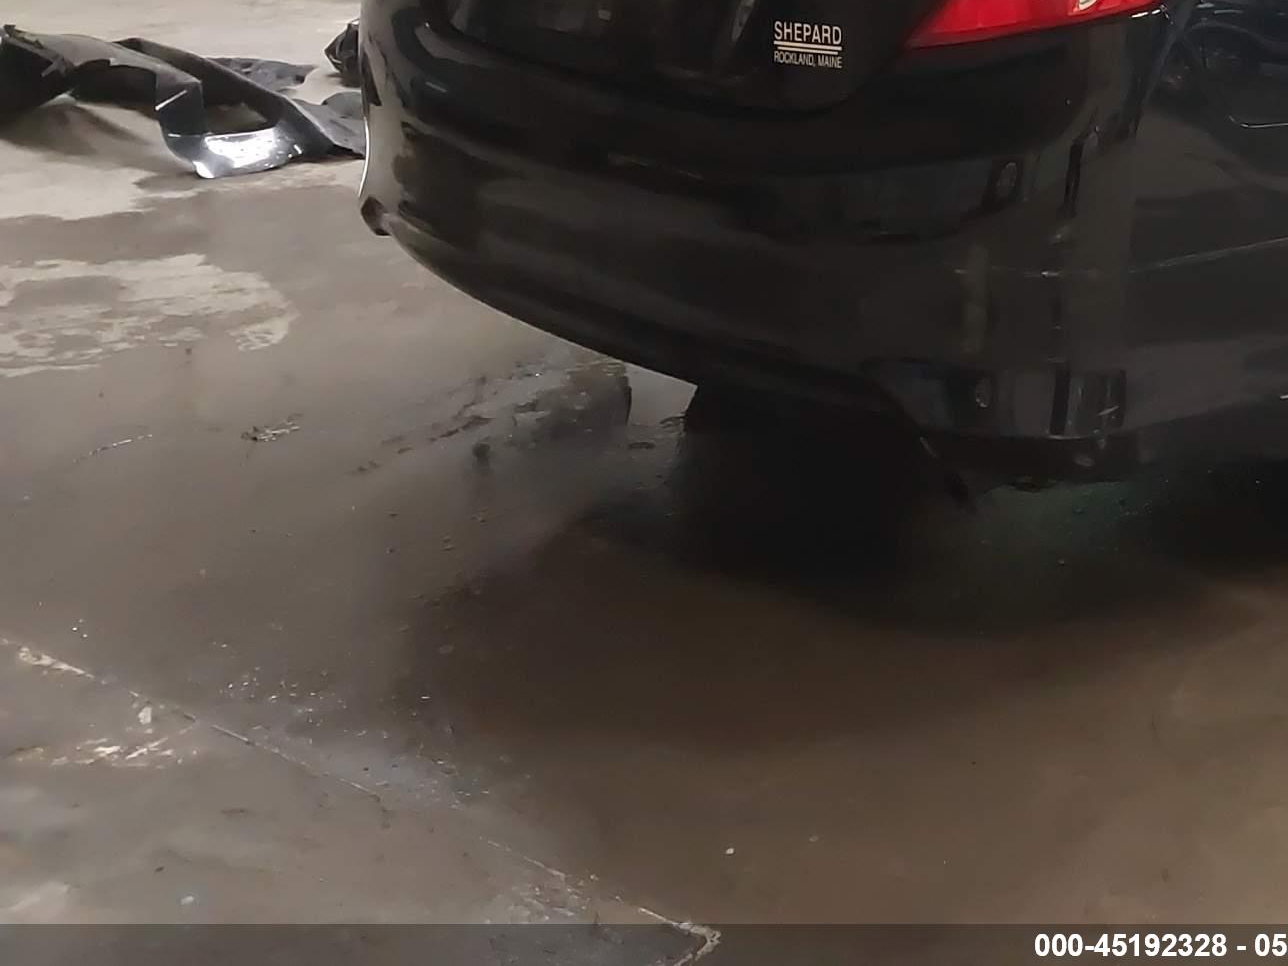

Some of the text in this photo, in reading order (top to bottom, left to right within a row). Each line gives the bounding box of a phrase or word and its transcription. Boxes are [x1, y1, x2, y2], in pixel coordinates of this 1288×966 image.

[773, 20, 843, 46] SHEPARD
[773, 49, 843, 69] ROCKLAND, MAINE
